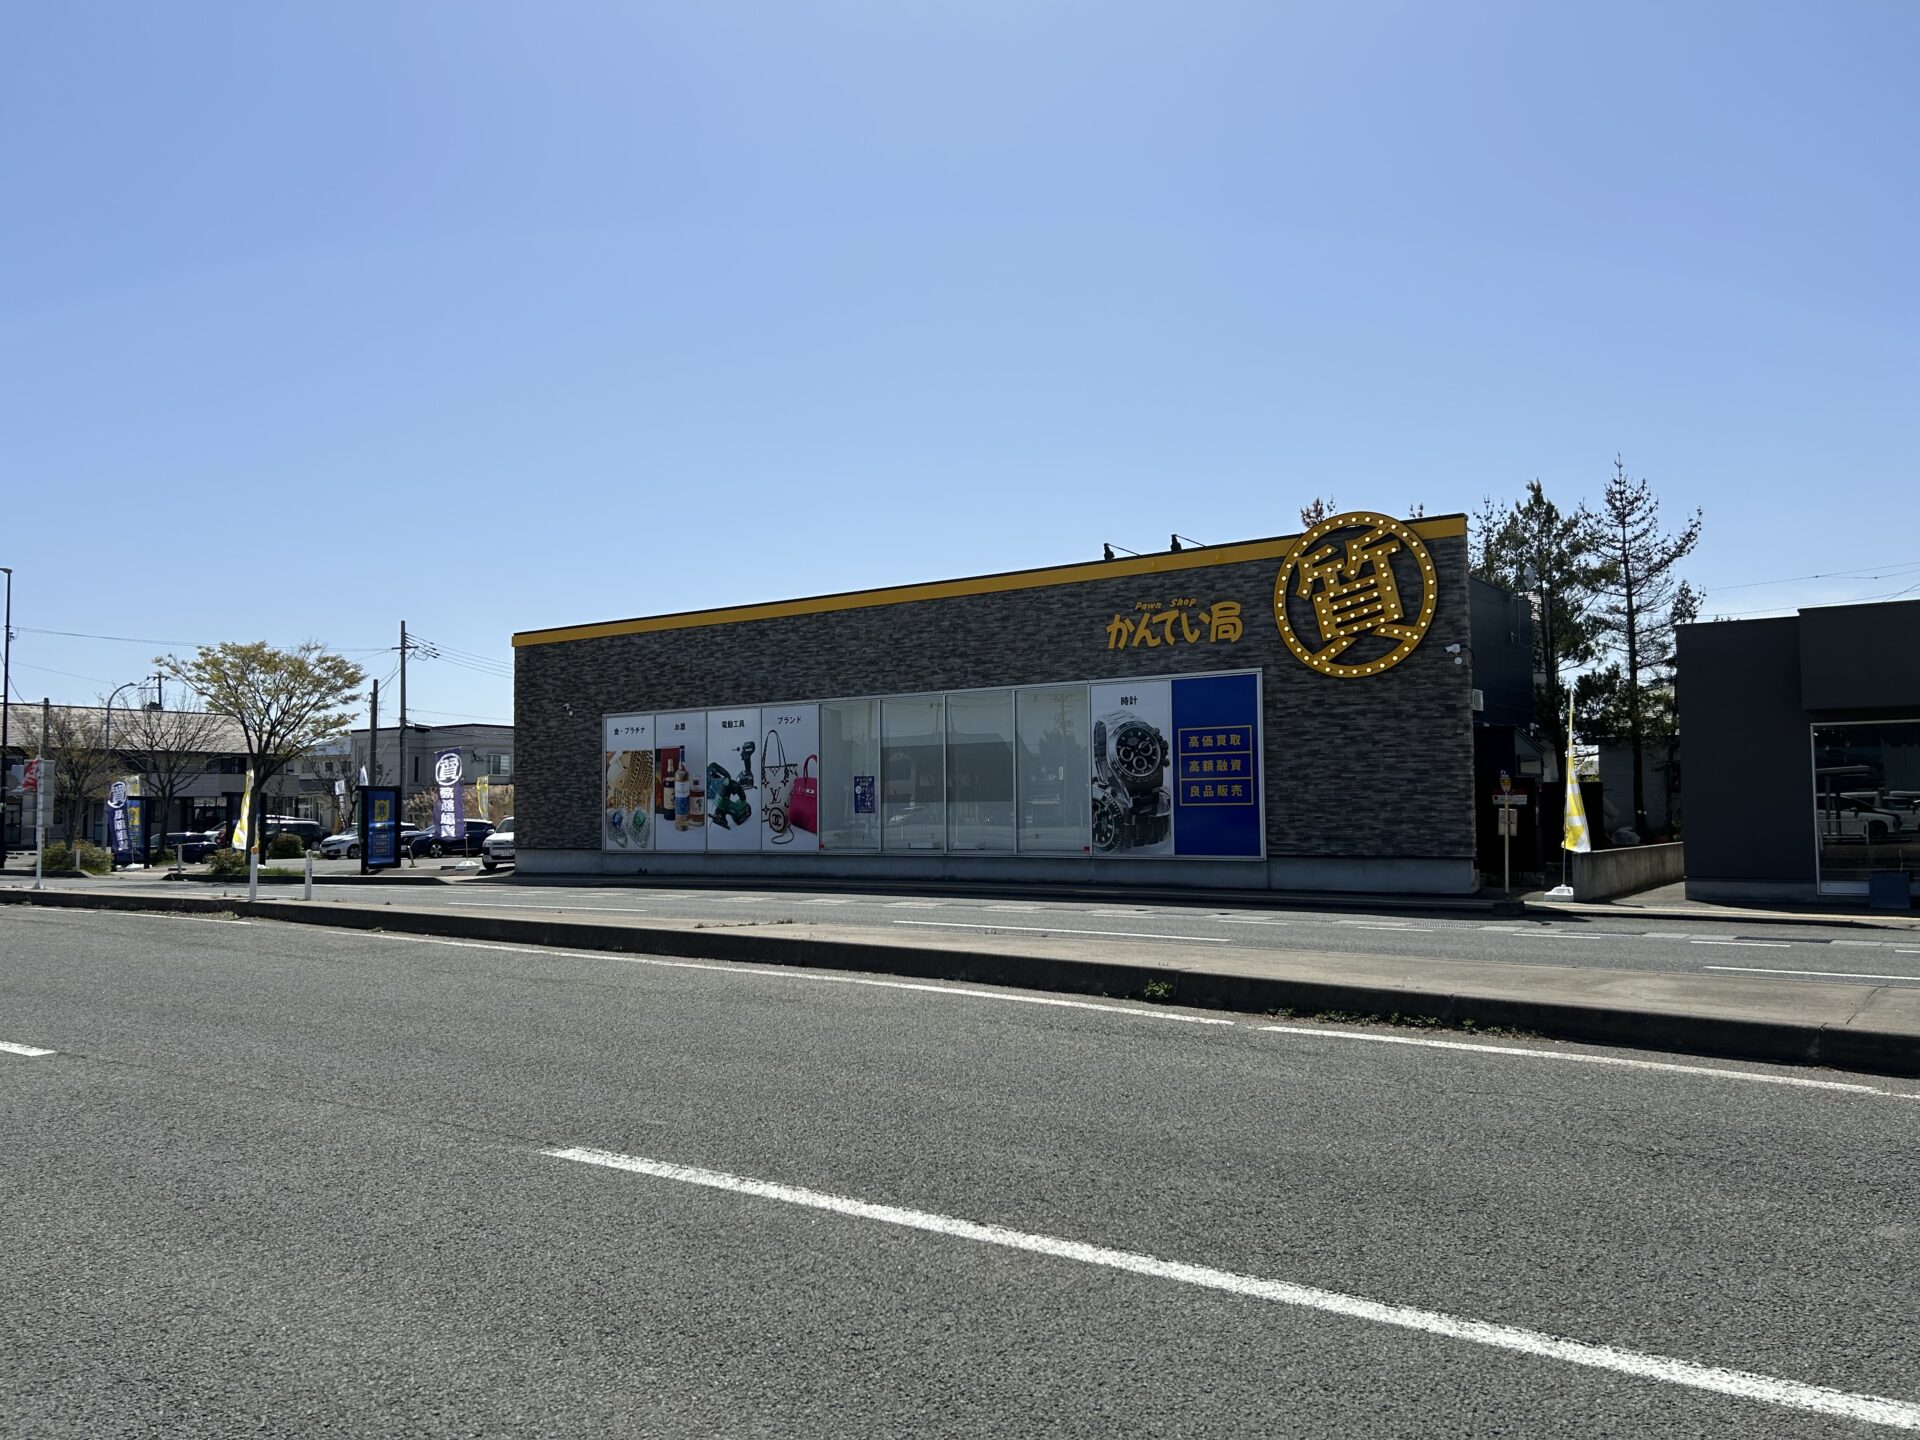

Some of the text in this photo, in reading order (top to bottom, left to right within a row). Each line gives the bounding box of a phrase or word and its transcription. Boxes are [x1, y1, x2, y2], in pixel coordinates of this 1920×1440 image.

[1290, 521, 1422, 668] 質
[1135, 598, 1197, 610] Pawn Shop
[1106, 601, 1244, 650] かんてい局
[1120, 696, 1138, 706] 時計
[721, 720, 745, 729] 電動工具
[777, 715, 802, 724] ブランド
[674, 723, 686, 731] お酒
[1188, 734, 1242, 748] 高価買取
[1189, 759, 1242, 772] 高額融資
[1190, 784, 1243, 798] 良品販売
